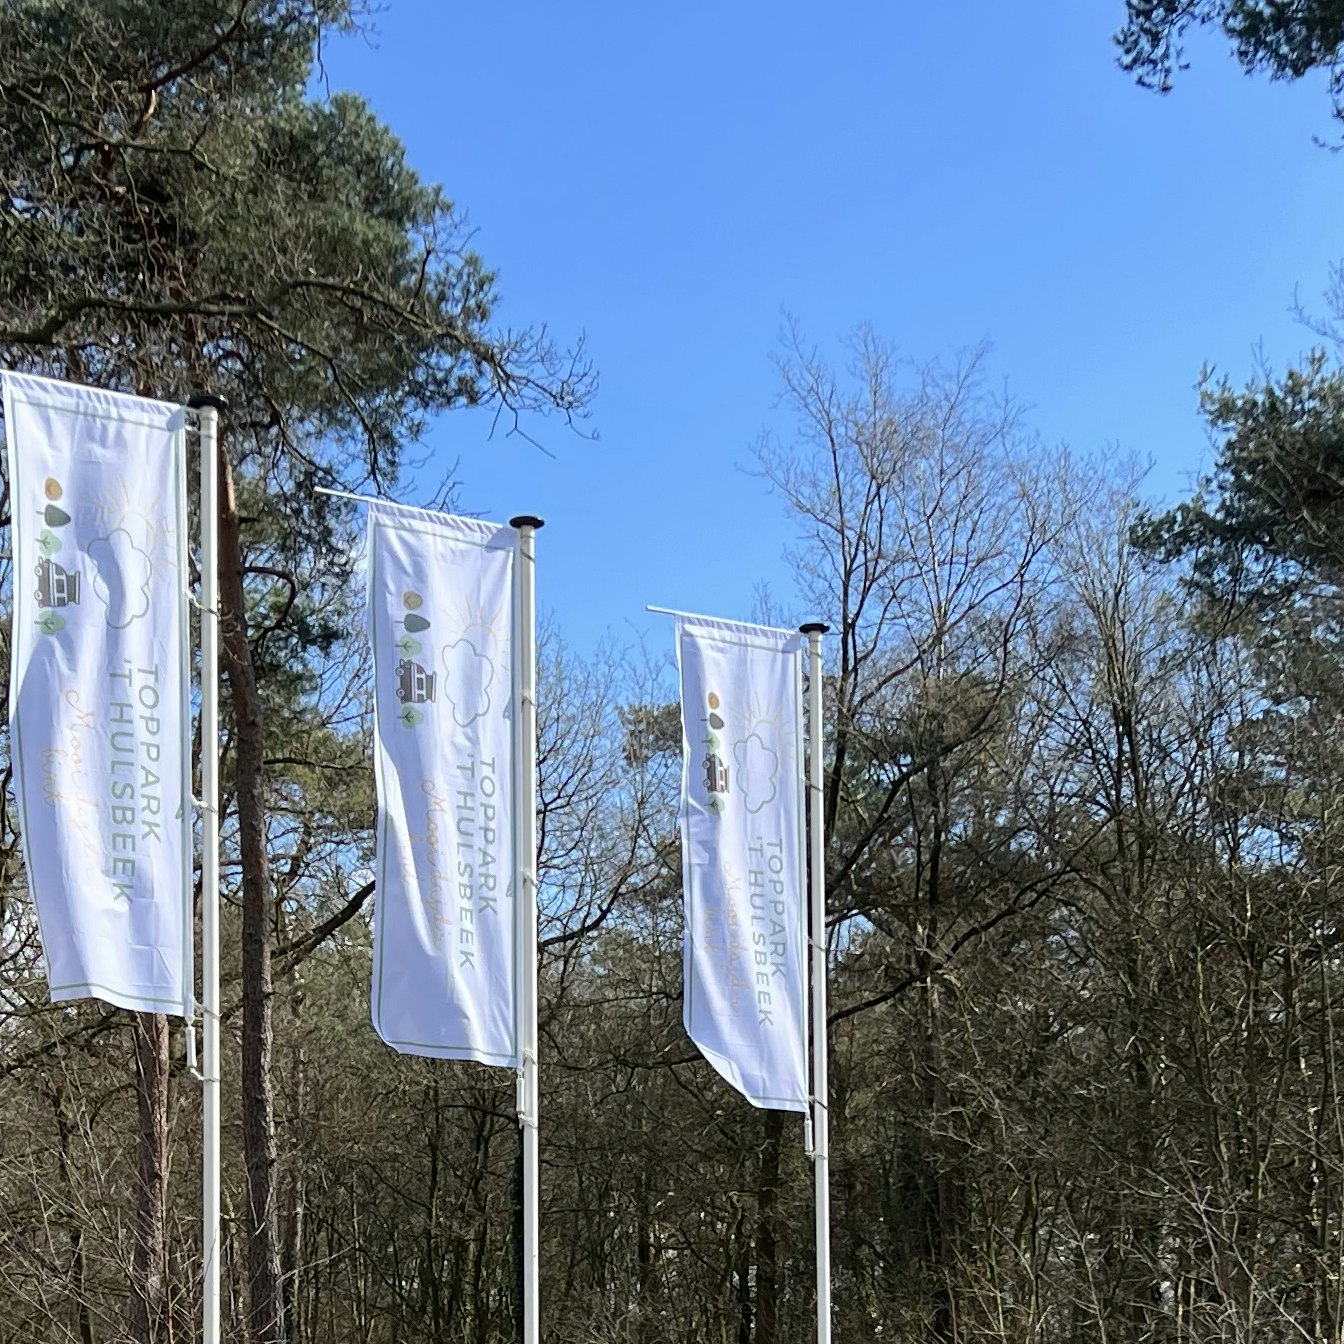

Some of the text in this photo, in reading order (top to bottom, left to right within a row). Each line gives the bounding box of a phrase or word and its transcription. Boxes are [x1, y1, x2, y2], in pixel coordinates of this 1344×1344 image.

[109, 703, 136, 904] HULSBEEK
[137, 664, 161, 843] TOPPARK
[478, 757, 497, 915] TOPPARK
[456, 790, 475, 968] HULSBEEK
[748, 869, 774, 1026] HULSBEEK
[767, 838, 786, 977] TOPPARK
